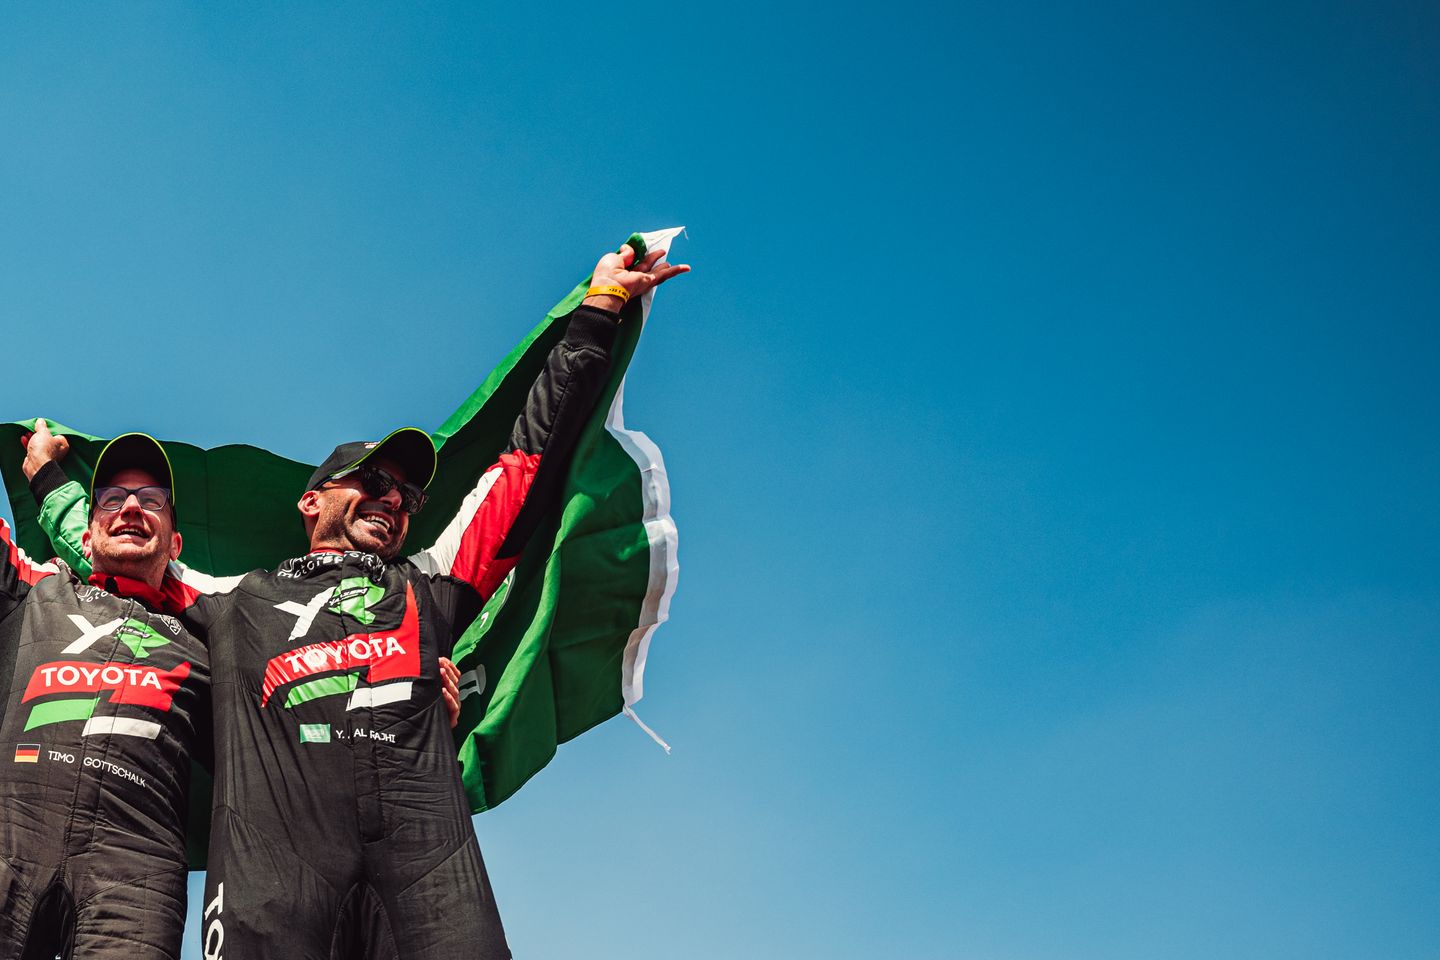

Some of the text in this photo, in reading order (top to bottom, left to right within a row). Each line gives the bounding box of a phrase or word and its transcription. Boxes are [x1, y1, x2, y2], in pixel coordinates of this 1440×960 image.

[285, 636, 407, 674] TOYOTA
[40, 665, 163, 690] TOYOTA
[47, 750, 146, 788] TIMO GOTTSCHALK
